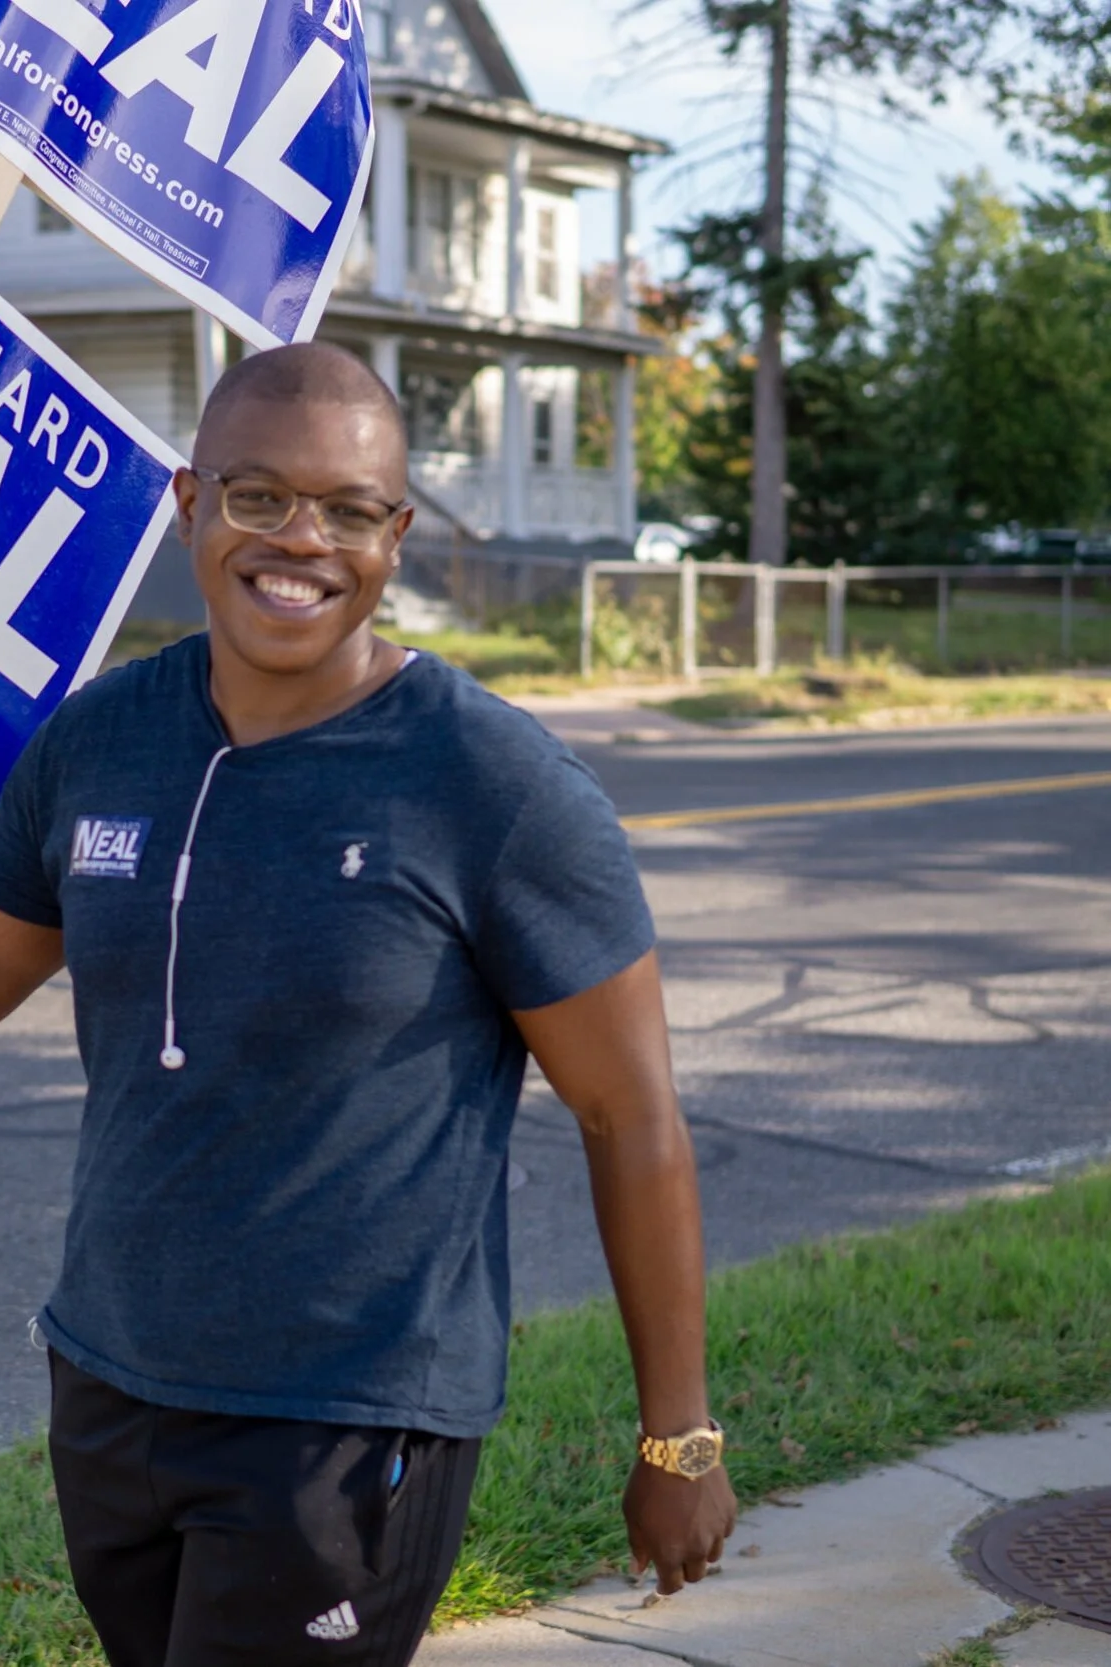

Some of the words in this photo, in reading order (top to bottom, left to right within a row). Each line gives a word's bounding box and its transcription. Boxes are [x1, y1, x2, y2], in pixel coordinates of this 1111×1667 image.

[1, 111, 10, 123] E.
[11, 117, 30, 137] Neal
[30, 131, 41, 146] for
[39, 140, 69, 174] Congress
[67, 168, 106, 207] Committee,
[108, 200, 138, 227] Michael
[143, 226, 161, 246] Hall,
[162, 239, 200, 270] Treasurer.
[10, 0, 345, 233] AL
[73, 820, 139, 860] NEAL
